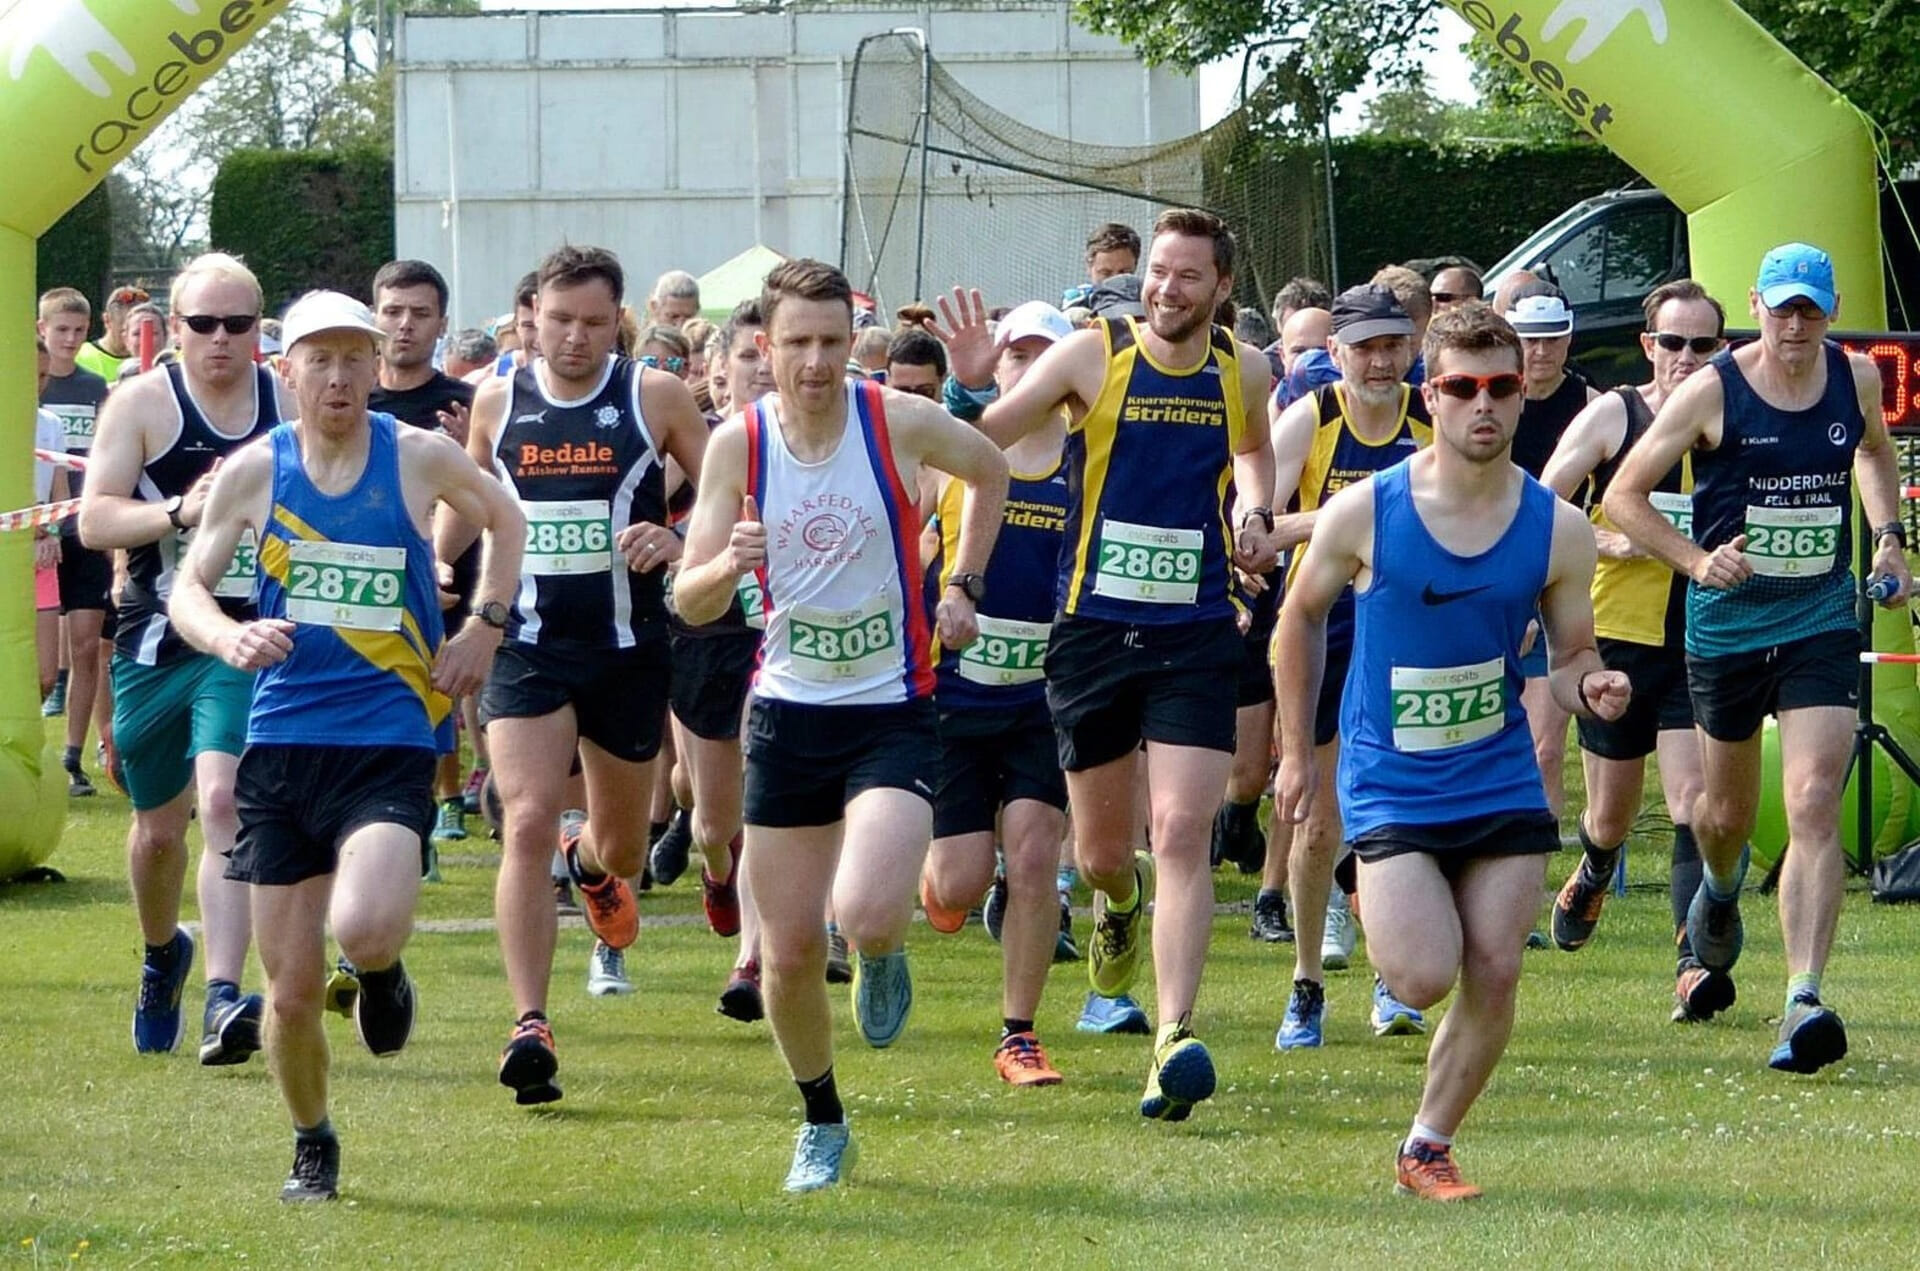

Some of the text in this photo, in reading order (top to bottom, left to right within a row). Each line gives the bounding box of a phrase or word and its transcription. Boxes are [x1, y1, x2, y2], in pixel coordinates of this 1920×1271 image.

[1446, 0, 1613, 135] ebest
[75, 0, 276, 172] racebe
[1125, 406, 1222, 426] Striders
[1127, 396, 1224, 410] Knaresborough
[521, 442, 613, 465] Bedale
[1749, 472, 1847, 490] NIDDERDALE
[1765, 495, 1789, 506] FELL
[1805, 493, 1832, 504] TRAIL
[777, 494, 877, 549] WHARFEDALE
[524, 522, 607, 553] 2886
[1747, 527, 1836, 556] 2863
[794, 551, 863, 569] HARRIERS
[1102, 543, 1197, 581] 2869
[291, 565, 400, 605] 2879
[793, 617, 890, 660] 2808
[1396, 682, 1501, 725] 2875
